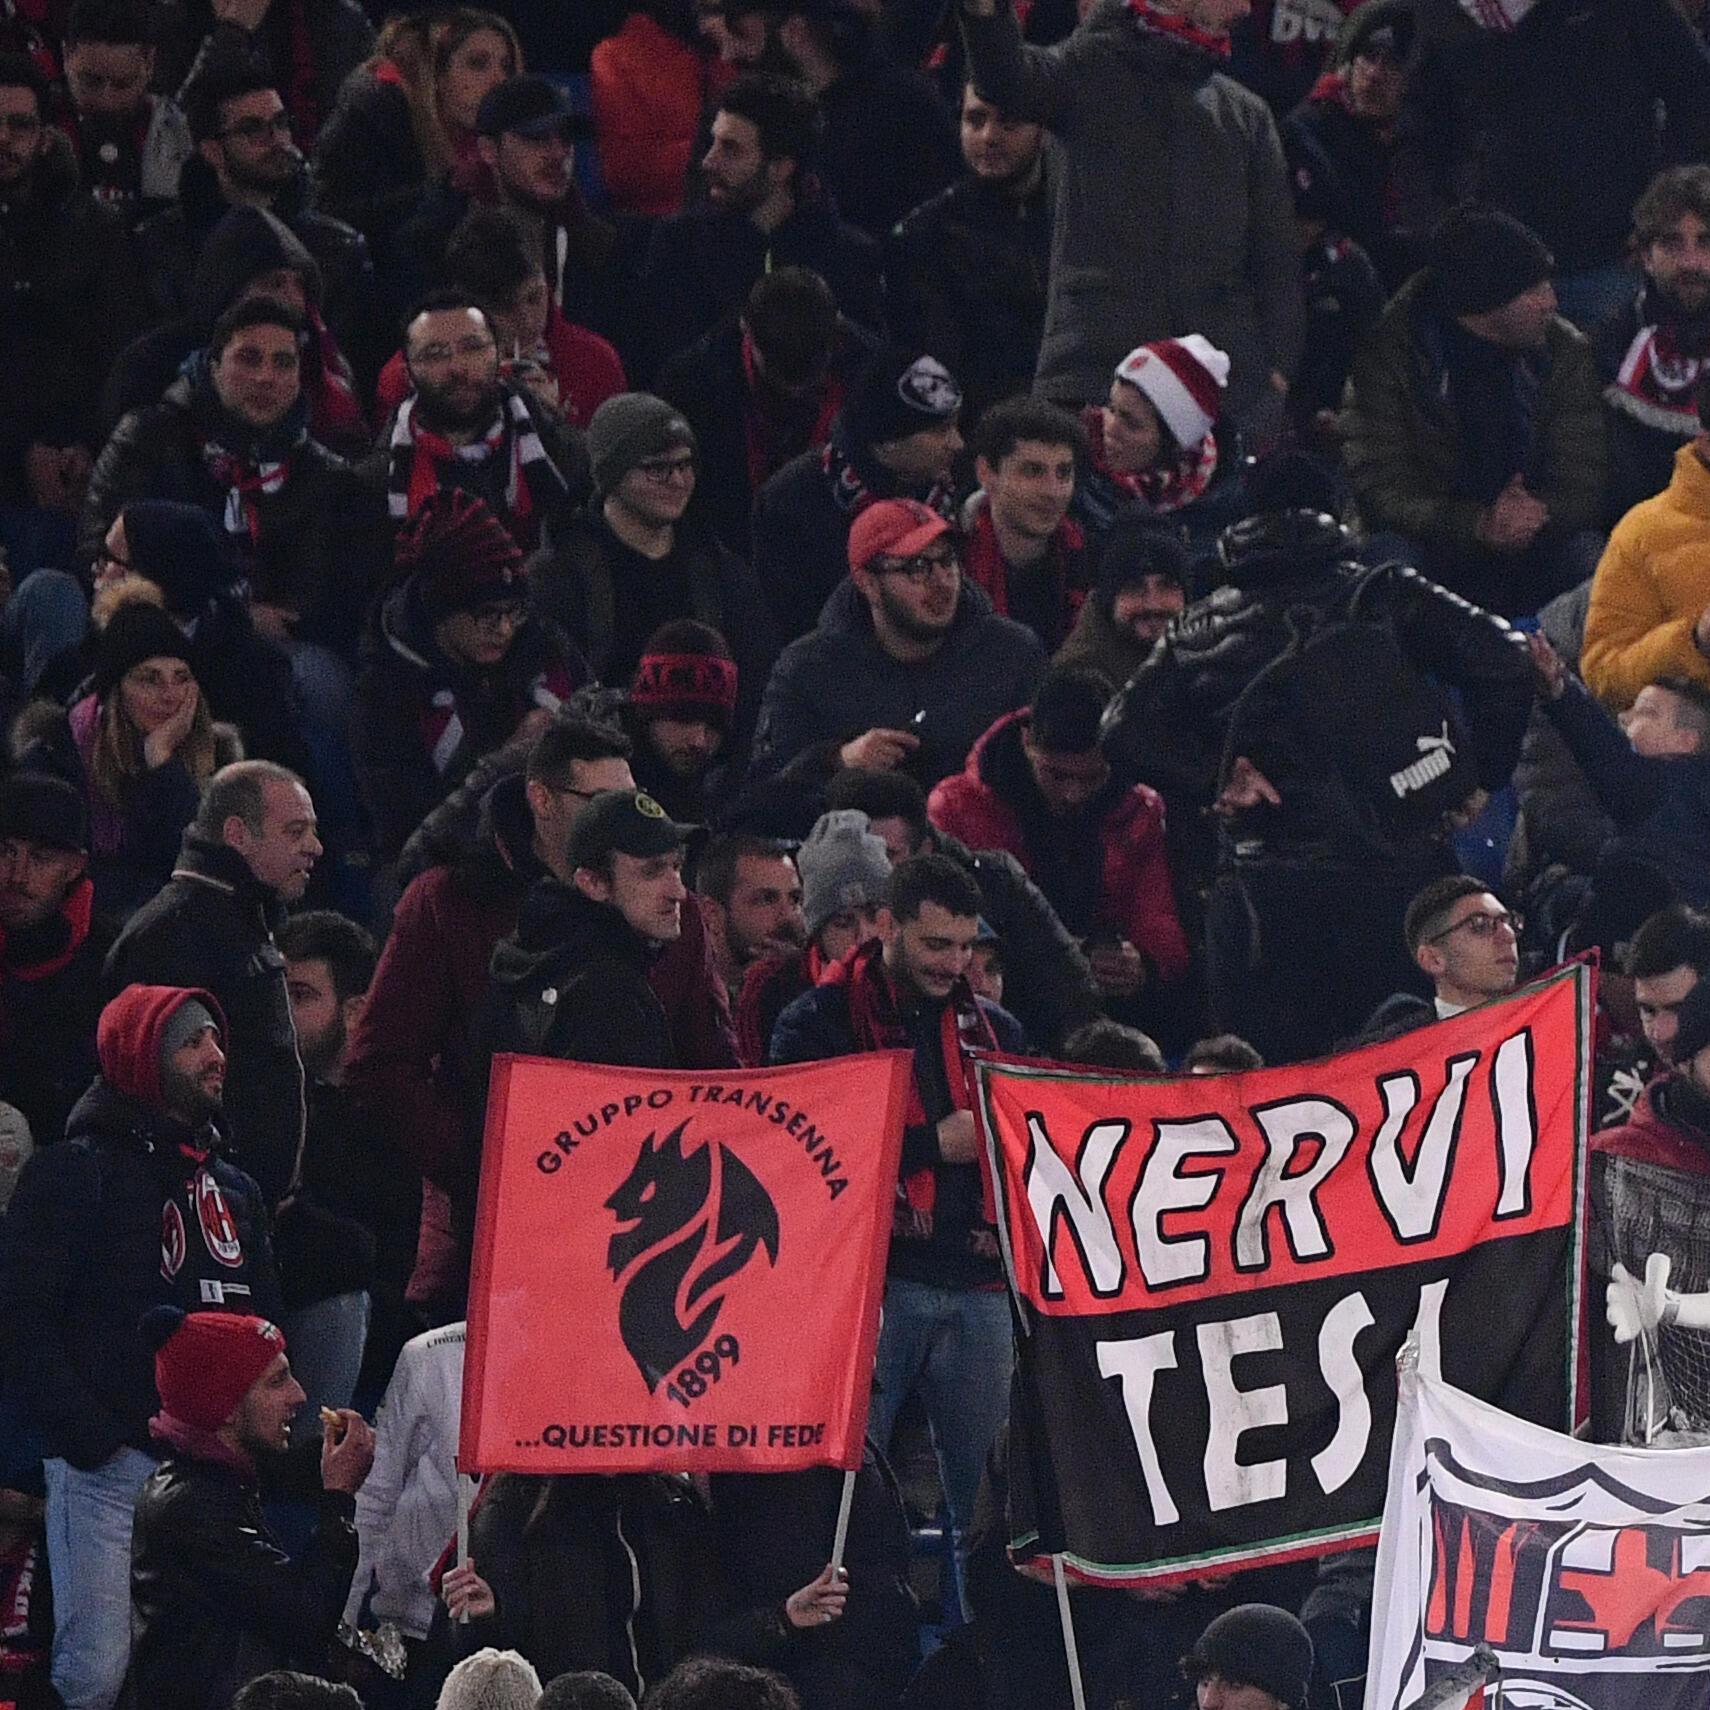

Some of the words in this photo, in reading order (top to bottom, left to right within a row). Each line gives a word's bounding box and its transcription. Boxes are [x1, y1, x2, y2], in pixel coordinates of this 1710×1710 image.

[1390, 746, 1451, 798] PUMA
[537, 1089, 673, 1175] GRUPPO
[688, 1084, 850, 1201] TRANSENNA
[1026, 1027, 1536, 1296] NERVI
[666, 1334, 742, 1409] 1899
[516, 1423, 718, 1450] ...QUESTIONE
[728, 1423, 762, 1449] DI
[768, 1422, 826, 1448] FEDE
